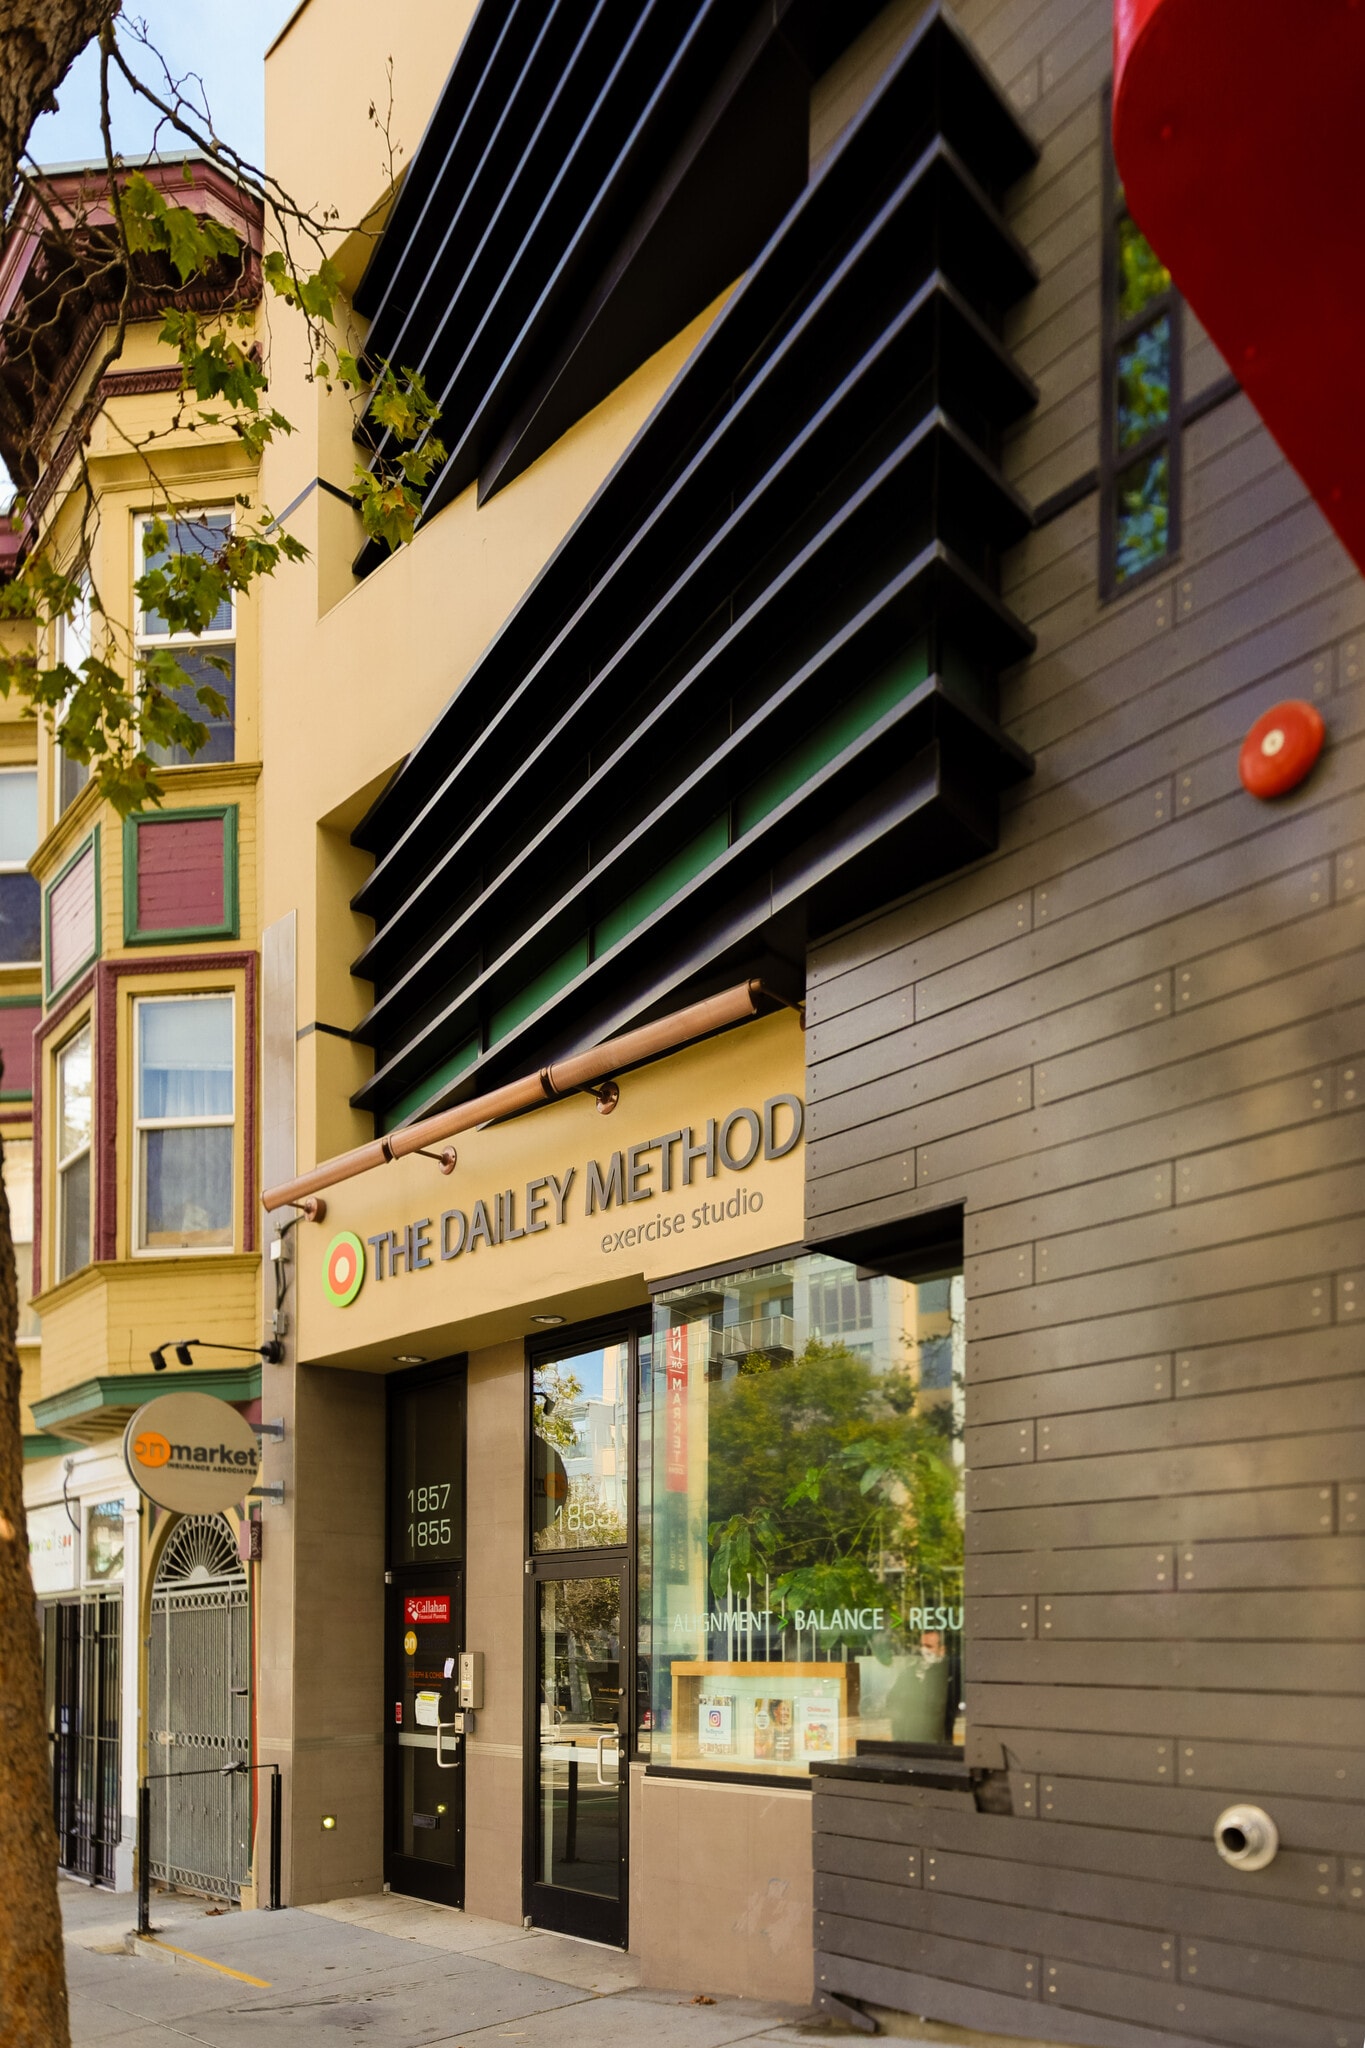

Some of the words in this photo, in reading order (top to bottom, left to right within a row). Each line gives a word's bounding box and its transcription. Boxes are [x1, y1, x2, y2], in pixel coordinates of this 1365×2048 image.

[367, 1217, 431, 1281] THE
[440, 1166, 575, 1262] DAILEY
[585, 1093, 804, 1217] METHOD
[600, 1213, 685, 1254] exercise
[691, 1187, 764, 1230] studio
[167, 1462, 211, 1473] INSURANCE
[212, 1466, 258, 1476] ASSOCIATES
[408, 1483, 451, 1513] 1857
[408, 1519, 451, 1548] 1855
[415, 1600, 447, 1613] Callahan
[673, 1611, 773, 1633] ALIGNMENT
[794, 1608, 884, 1631] BALANCE
[909, 1607, 965, 1631] RESU
